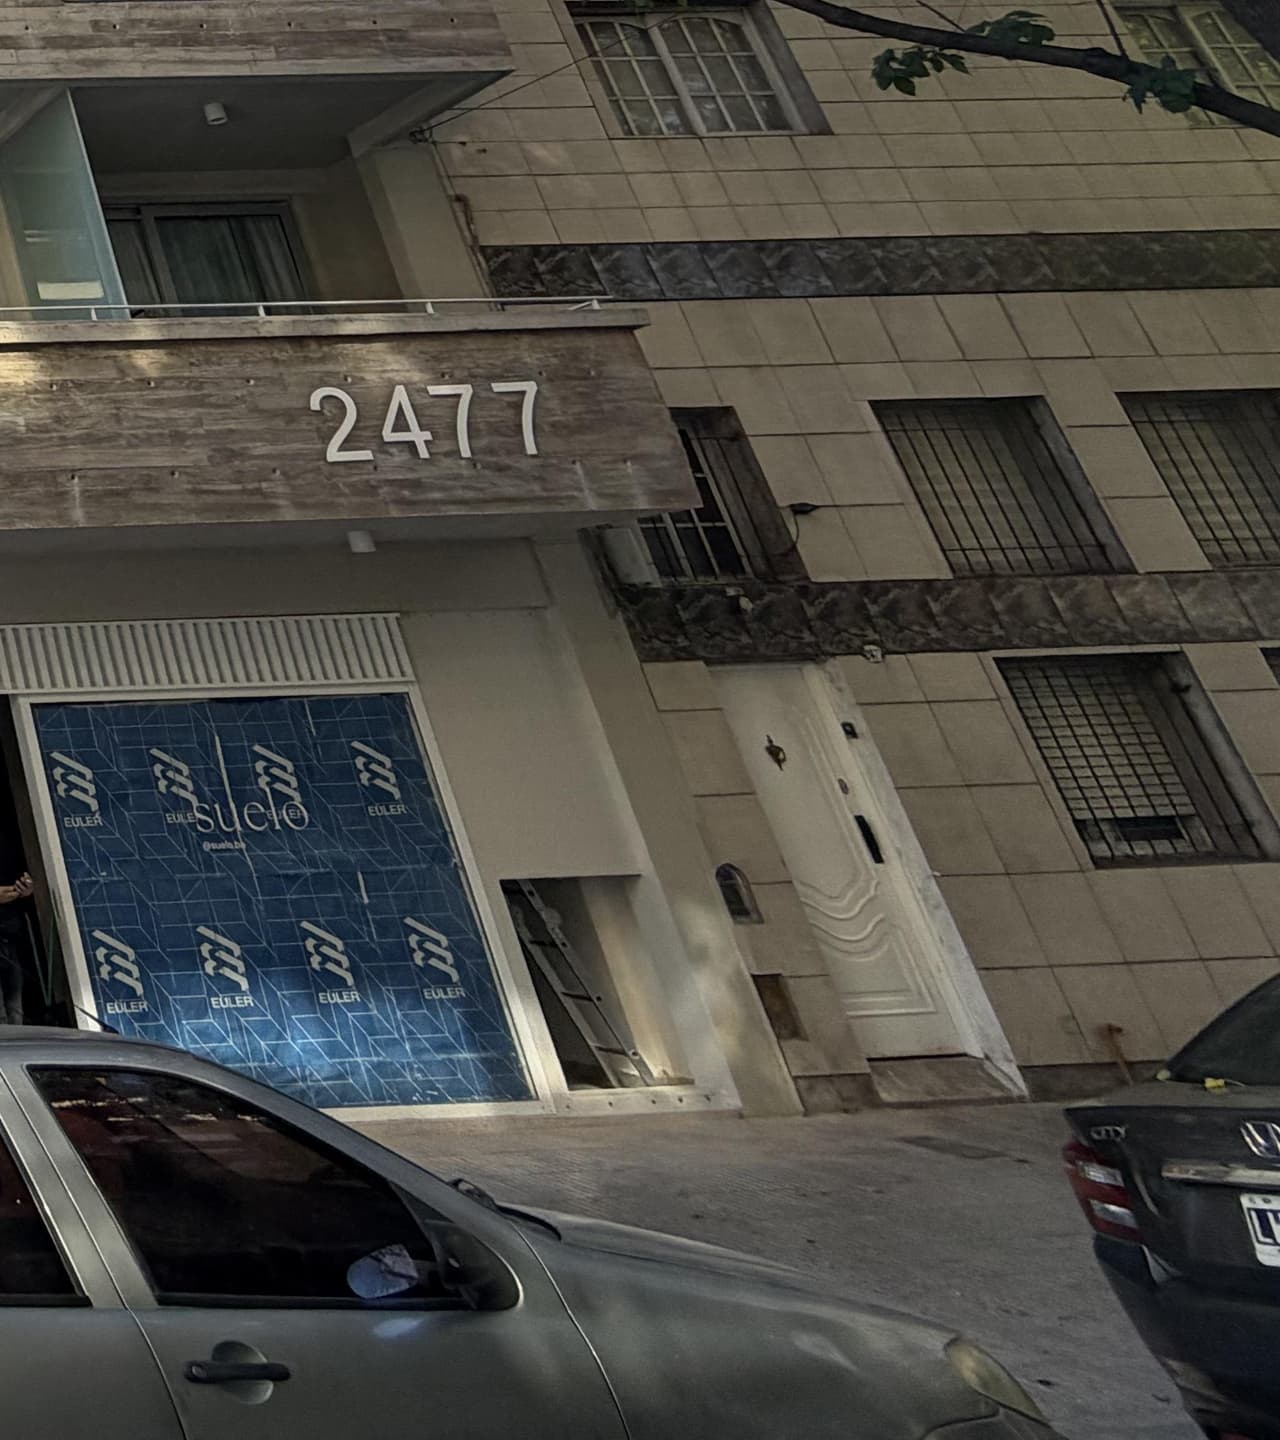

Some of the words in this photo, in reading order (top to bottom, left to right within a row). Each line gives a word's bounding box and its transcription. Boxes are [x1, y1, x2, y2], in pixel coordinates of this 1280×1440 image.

[308, 380, 539, 462] 2477
[193, 784, 309, 832] suelo
[368, 804, 407, 817] EULER
[64, 815, 103, 828] EULER
[318, 991, 360, 1004] EULER
[422, 986, 466, 1000] EULER
[107, 1000, 149, 1014] EULER
[210, 995, 254, 1009] EULER
